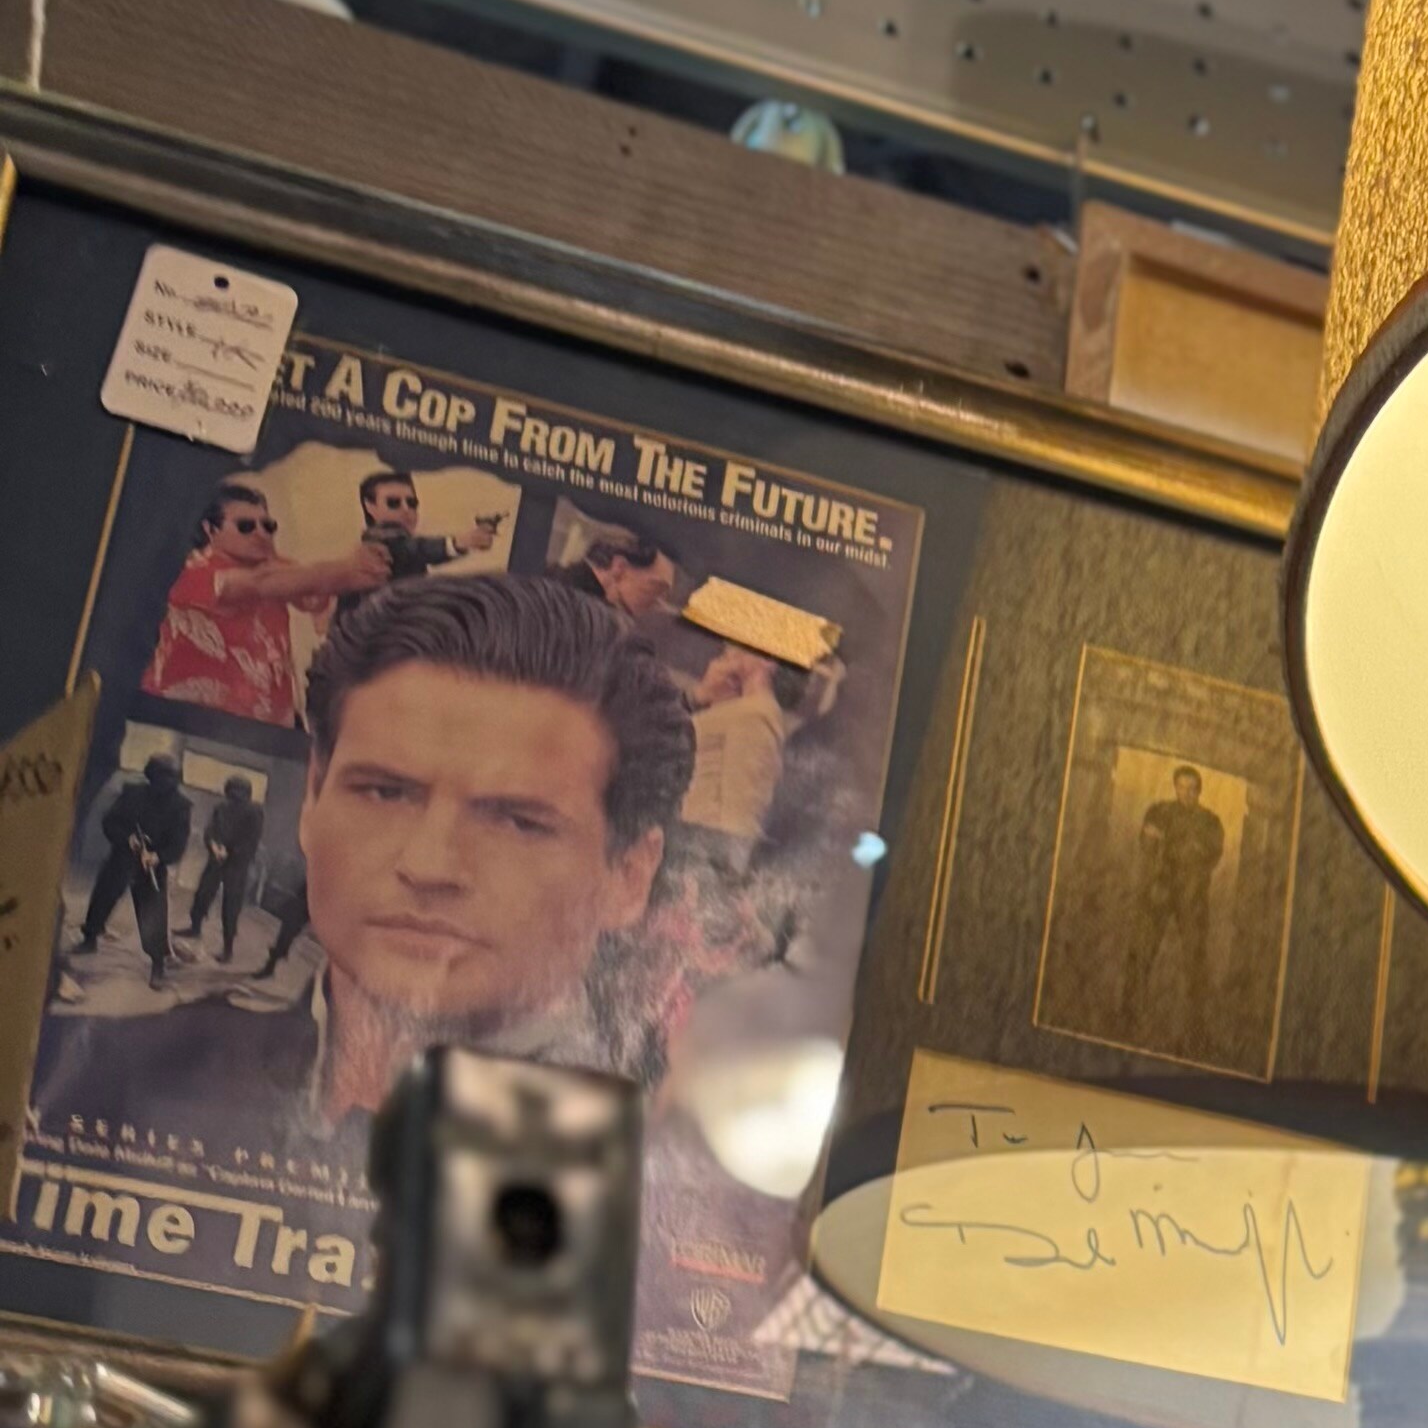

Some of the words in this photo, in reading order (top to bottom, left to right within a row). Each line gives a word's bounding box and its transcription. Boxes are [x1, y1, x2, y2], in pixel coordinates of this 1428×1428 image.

[324, 353, 365, 408] A
[346, 408, 391, 436] years
[396, 419, 458, 454] through
[462, 438, 498, 464] time
[503, 448, 520, 469] to
[523, 456, 565, 482] catch
[569, 467, 594, 490] the
[599, 478, 638, 503] most
[642, 489, 716, 522] notorious
[720, 508, 792, 543] criminals
[797, 529, 812, 548] in
[815, 536, 840, 555] our
